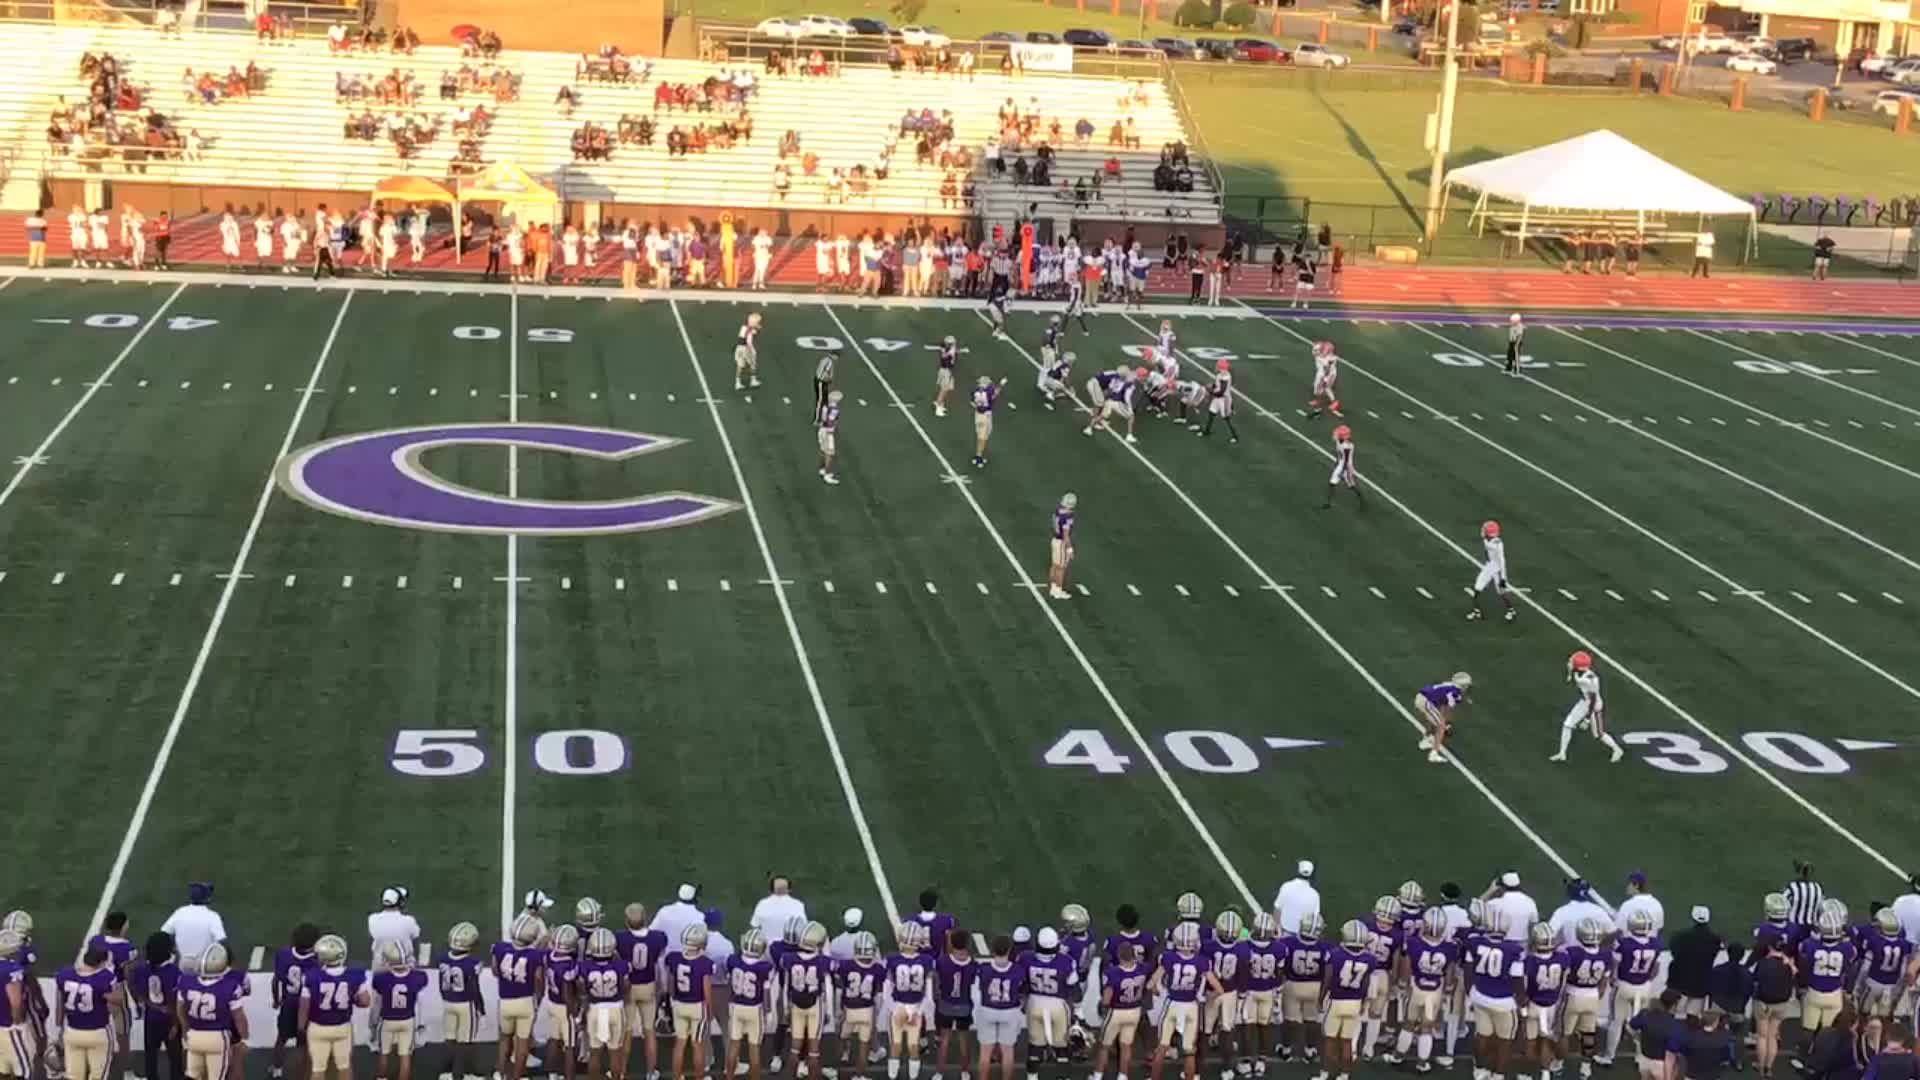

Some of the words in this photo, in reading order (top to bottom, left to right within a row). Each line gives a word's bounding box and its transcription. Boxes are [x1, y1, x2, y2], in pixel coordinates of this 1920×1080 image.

[452, 325, 575, 342] 50
[795, 336, 911, 351] 40
[276, 421, 744, 536] C
[391, 729, 625, 776] 50
[1043, 729, 1260, 773] 40
[1621, 731, 1851, 774] 30
[499, 953, 528, 984] 44
[632, 942, 648, 970] 0
[1292, 948, 1321, 977] 65
[1418, 951, 1446, 976] 42
[1475, 945, 1503, 977] 70
[1629, 949, 1656, 974] 17
[1813, 949, 1844, 977] 29
[588, 970, 618, 998] 32
[676, 964, 691, 993] 5
[847, 972, 875, 999] 34
[1029, 967, 1058, 994] 55
[1172, 963, 1197, 991] 12
[1339, 960, 1369, 989] 47
[64, 981, 94, 1013] 73
[319, 982, 350, 1010] 74
[988, 978, 1011, 1002] 41
[187, 990, 217, 1021] 72
